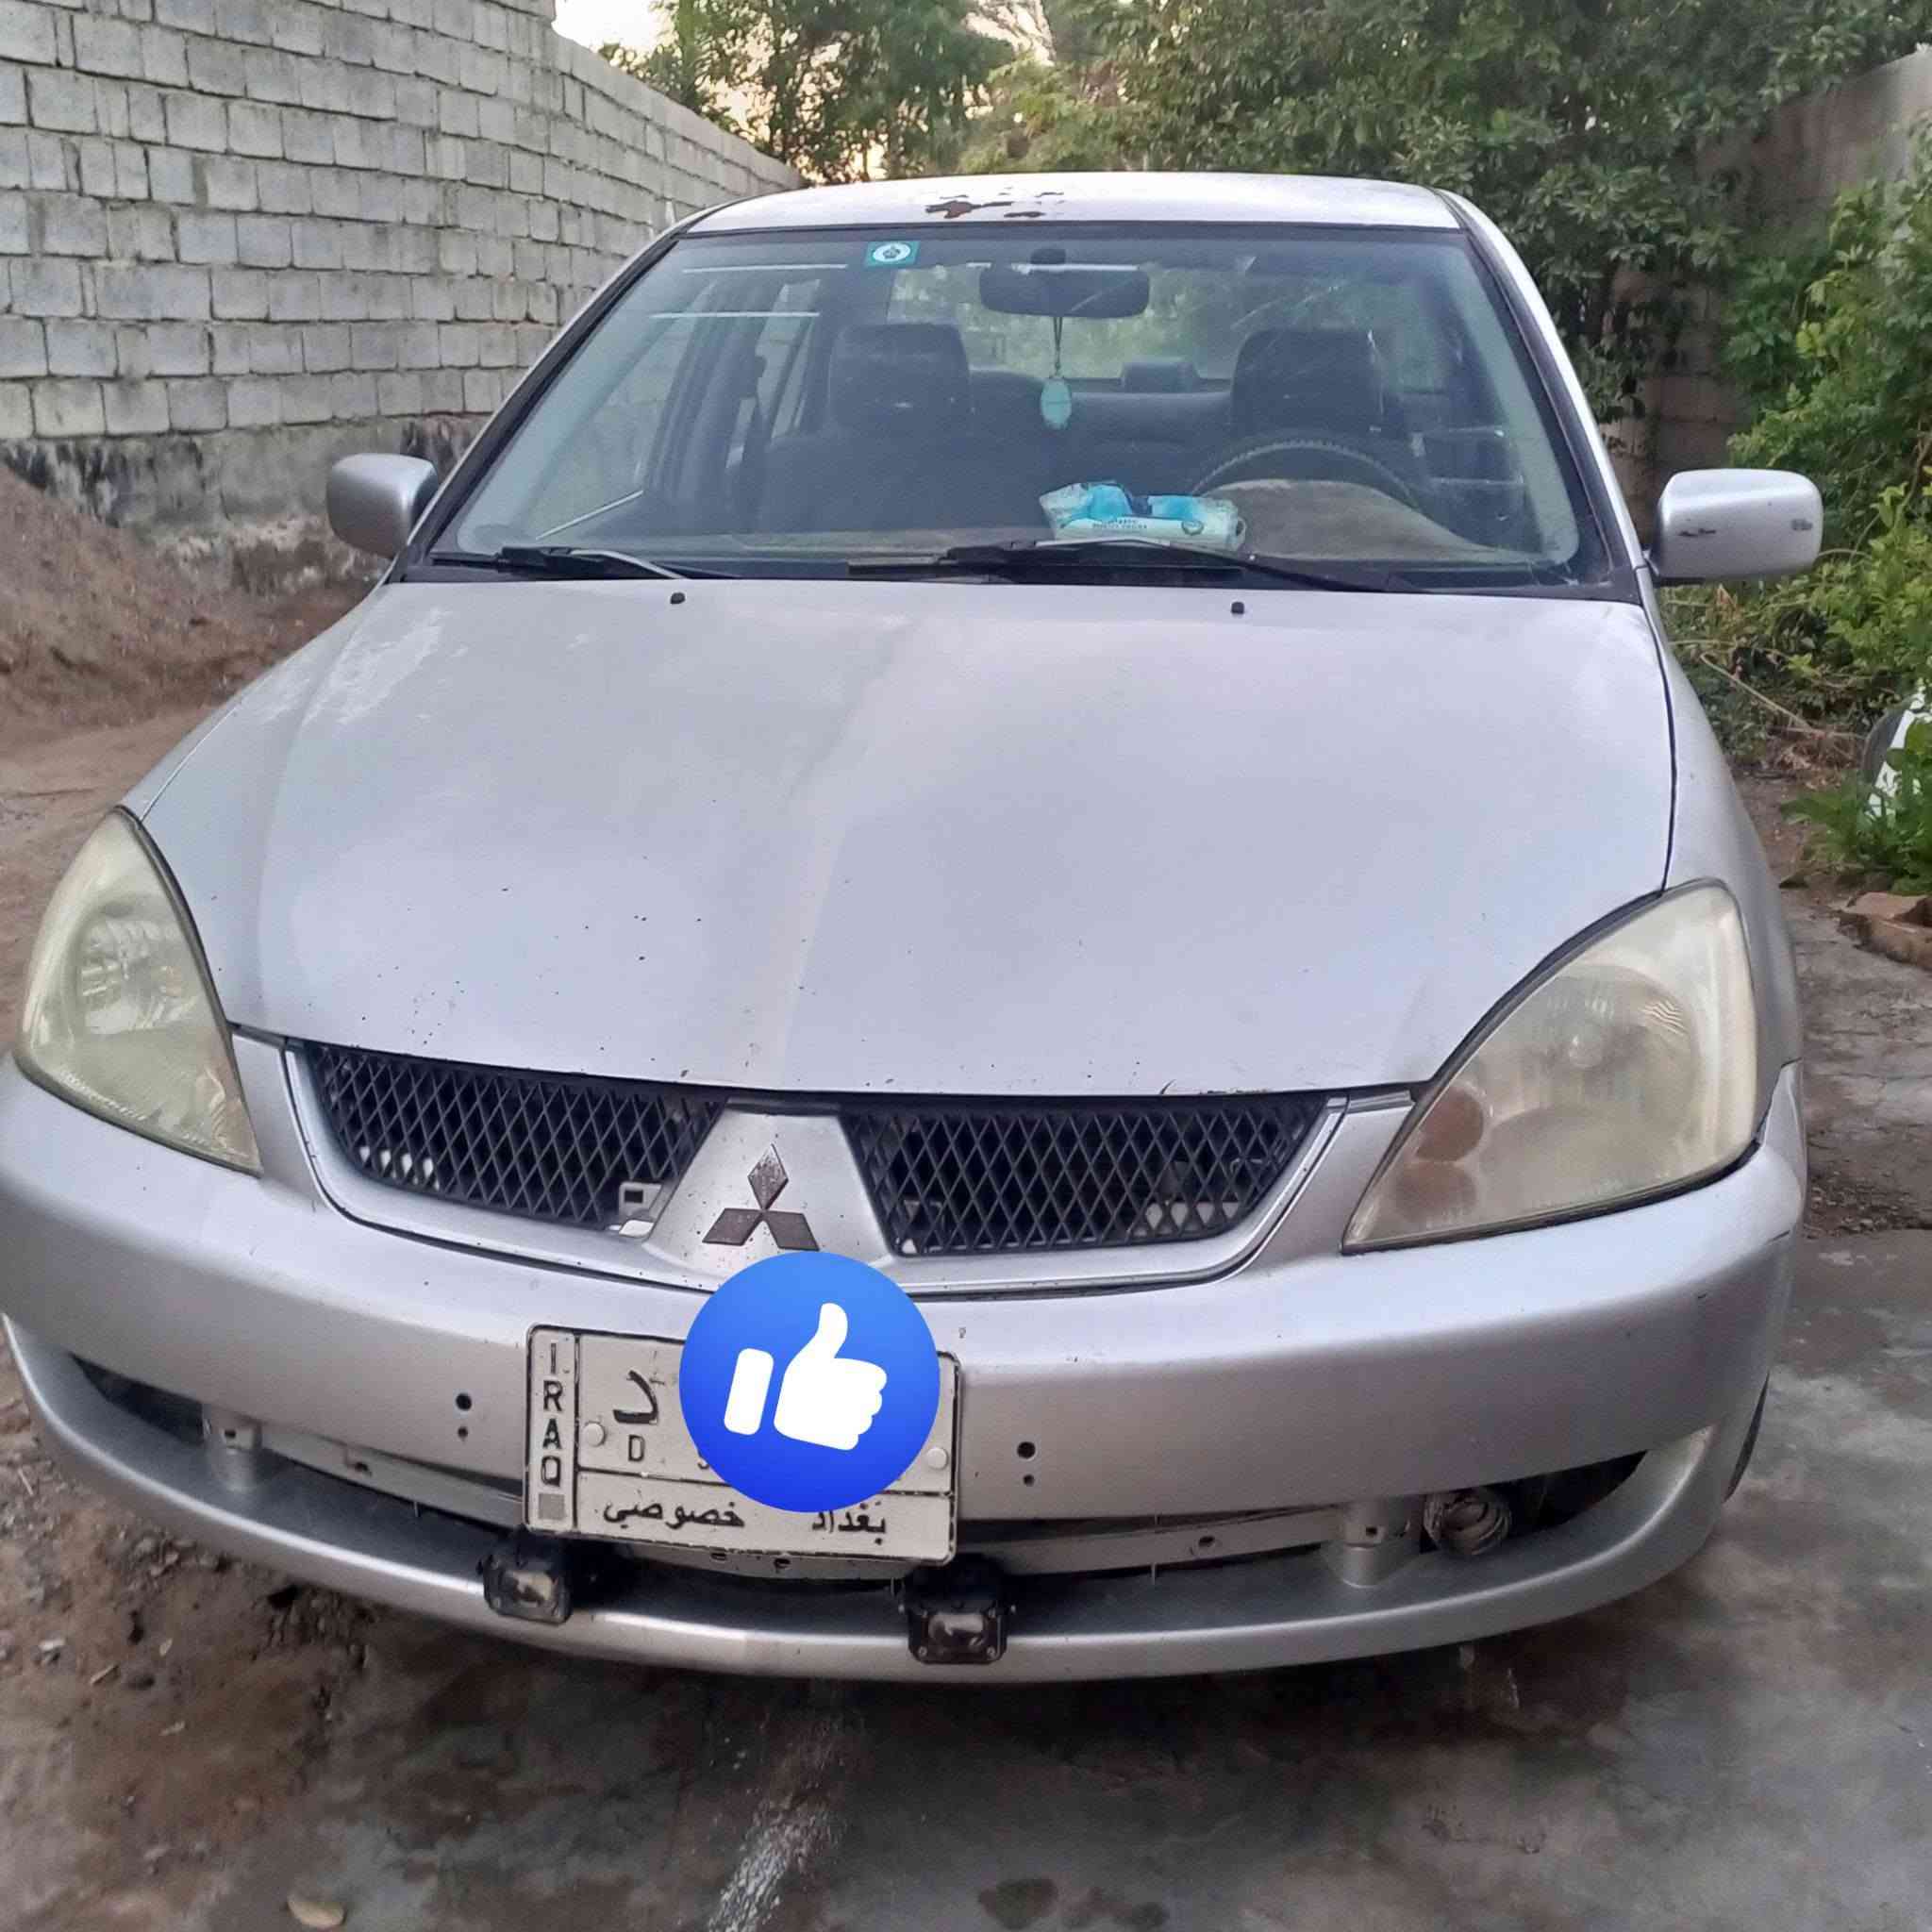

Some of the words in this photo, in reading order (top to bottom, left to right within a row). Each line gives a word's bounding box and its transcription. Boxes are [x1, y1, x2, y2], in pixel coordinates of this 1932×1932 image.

[541, 1342, 563, 1487] IRAQ
[613, 1370, 658, 1424] د
[628, 1434, 645, 1462] D
[604, 1501, 744, 1529] خصوصي
